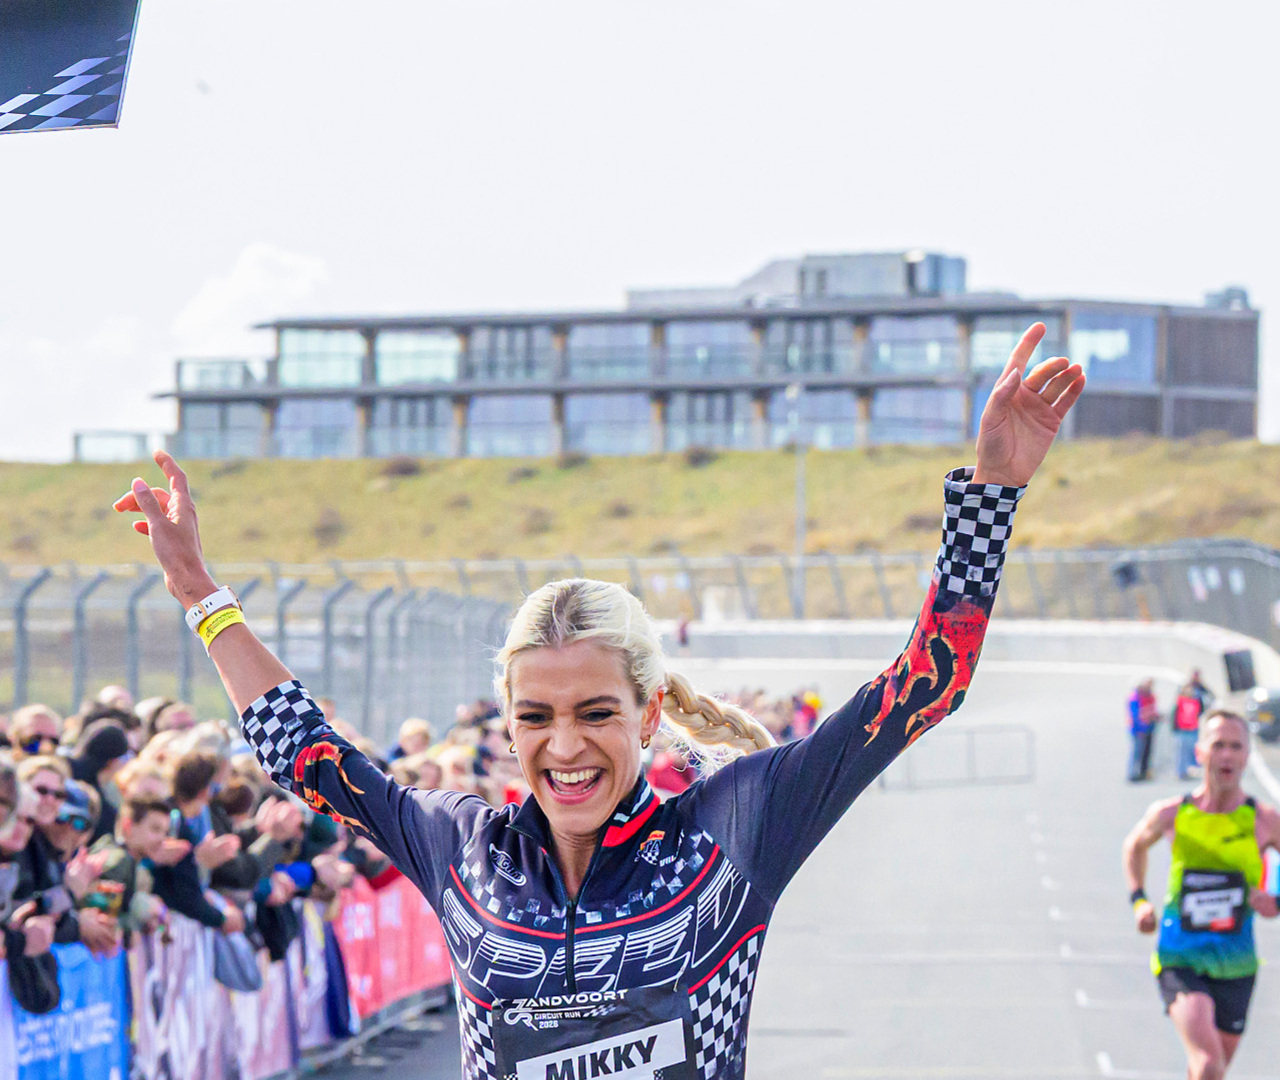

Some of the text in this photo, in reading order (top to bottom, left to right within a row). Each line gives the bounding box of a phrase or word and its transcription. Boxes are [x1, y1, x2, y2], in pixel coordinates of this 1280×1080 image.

[441, 856, 751, 998] SPEED
[512, 989, 628, 1012] ZANDVOORT
[534, 1011, 581, 1020] CIRCUIT RUN
